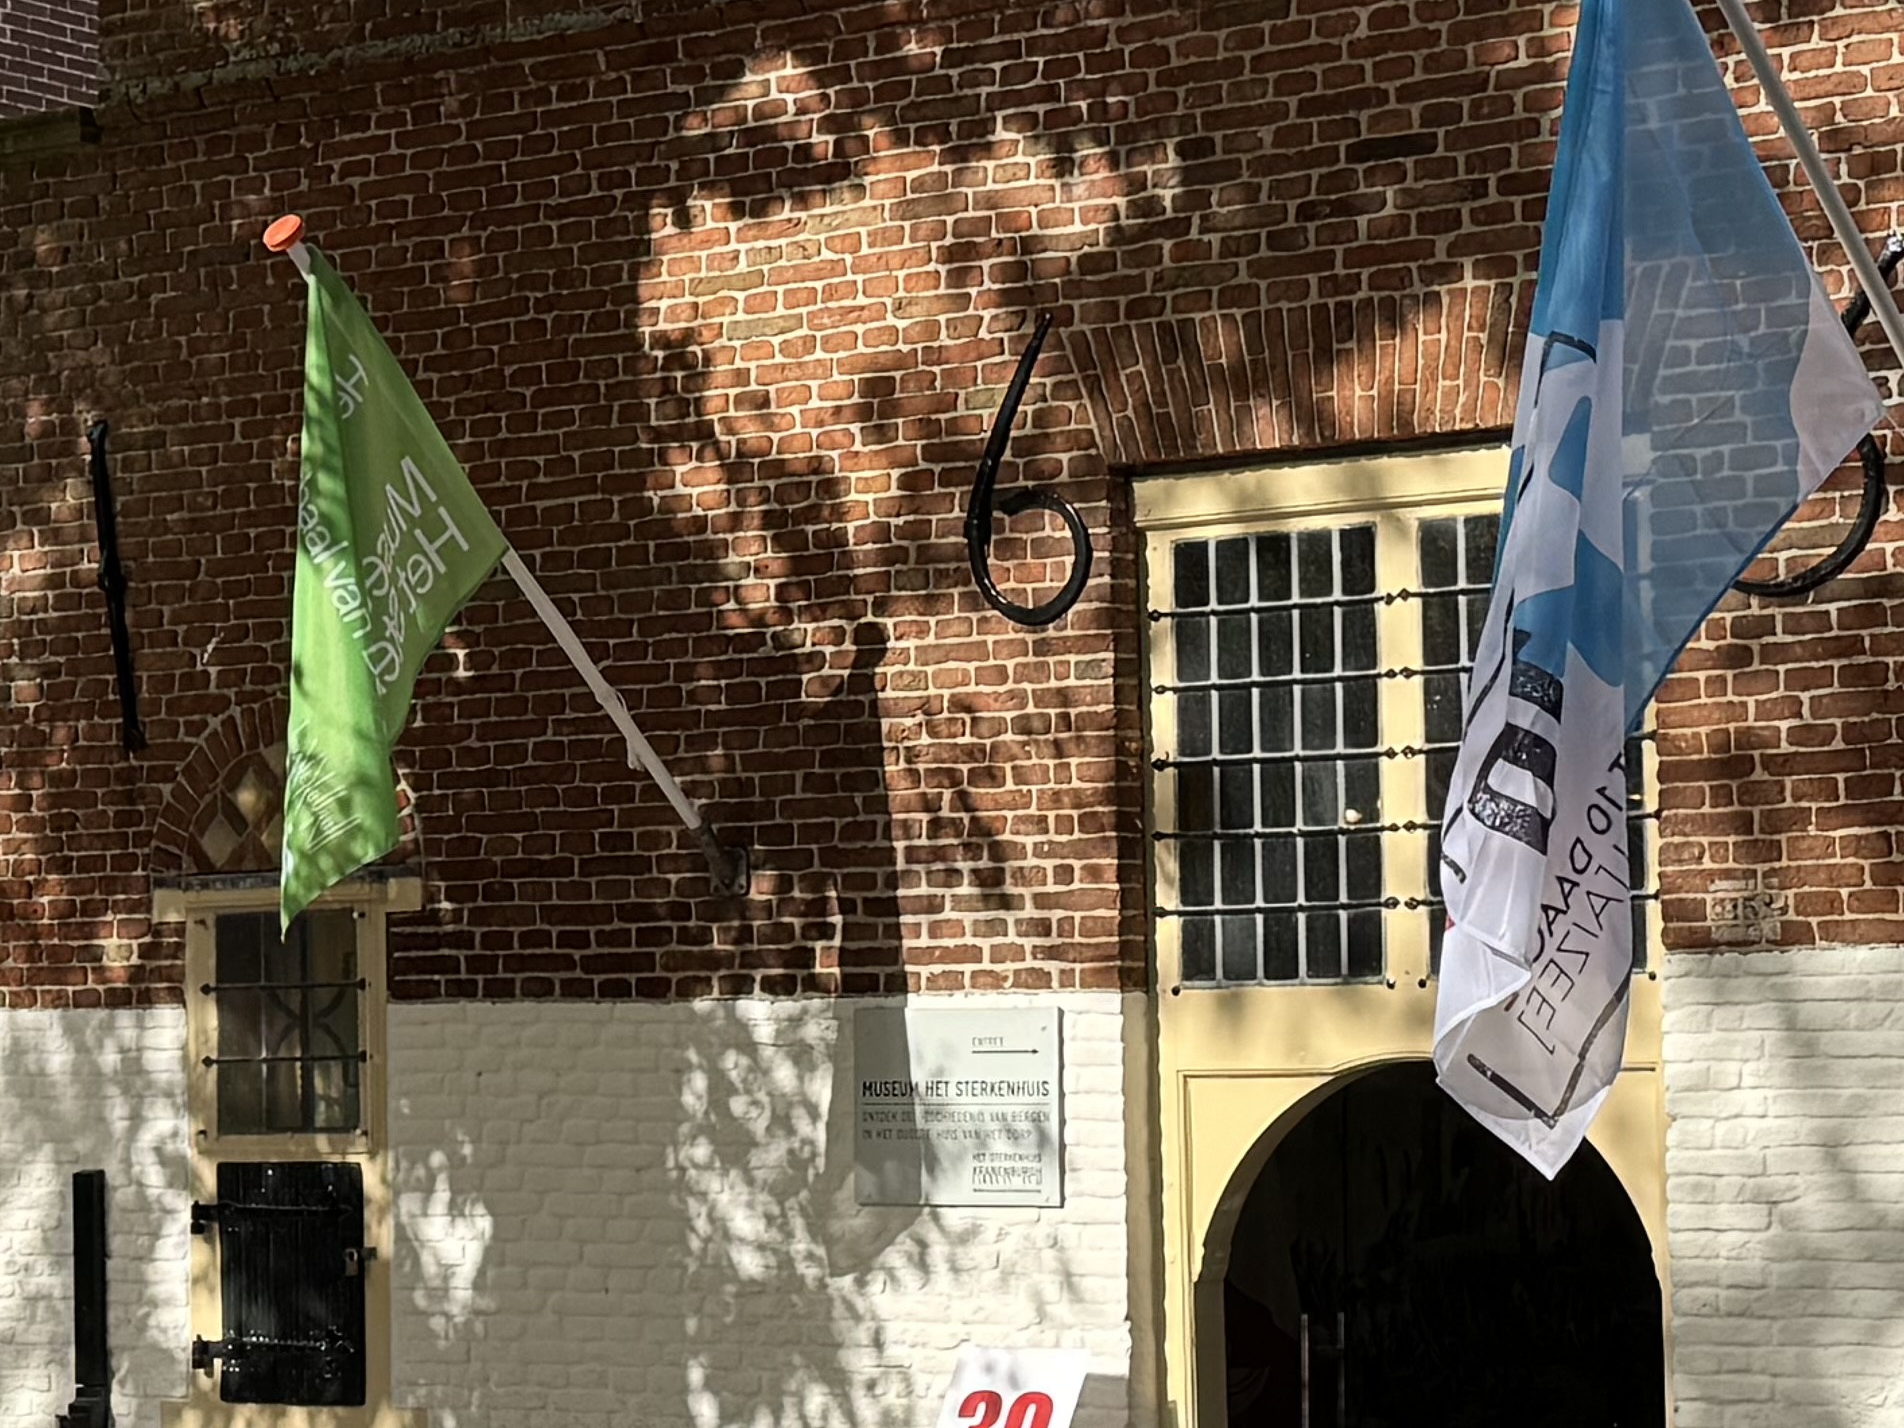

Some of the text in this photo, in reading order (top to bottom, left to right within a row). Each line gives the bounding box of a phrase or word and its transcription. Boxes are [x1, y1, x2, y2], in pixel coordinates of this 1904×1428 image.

[964, 312, 1094, 627] 6
[323, 569, 372, 639] van
[862, 1080, 1050, 1098] MUSEUM HET STERKENHUIS
